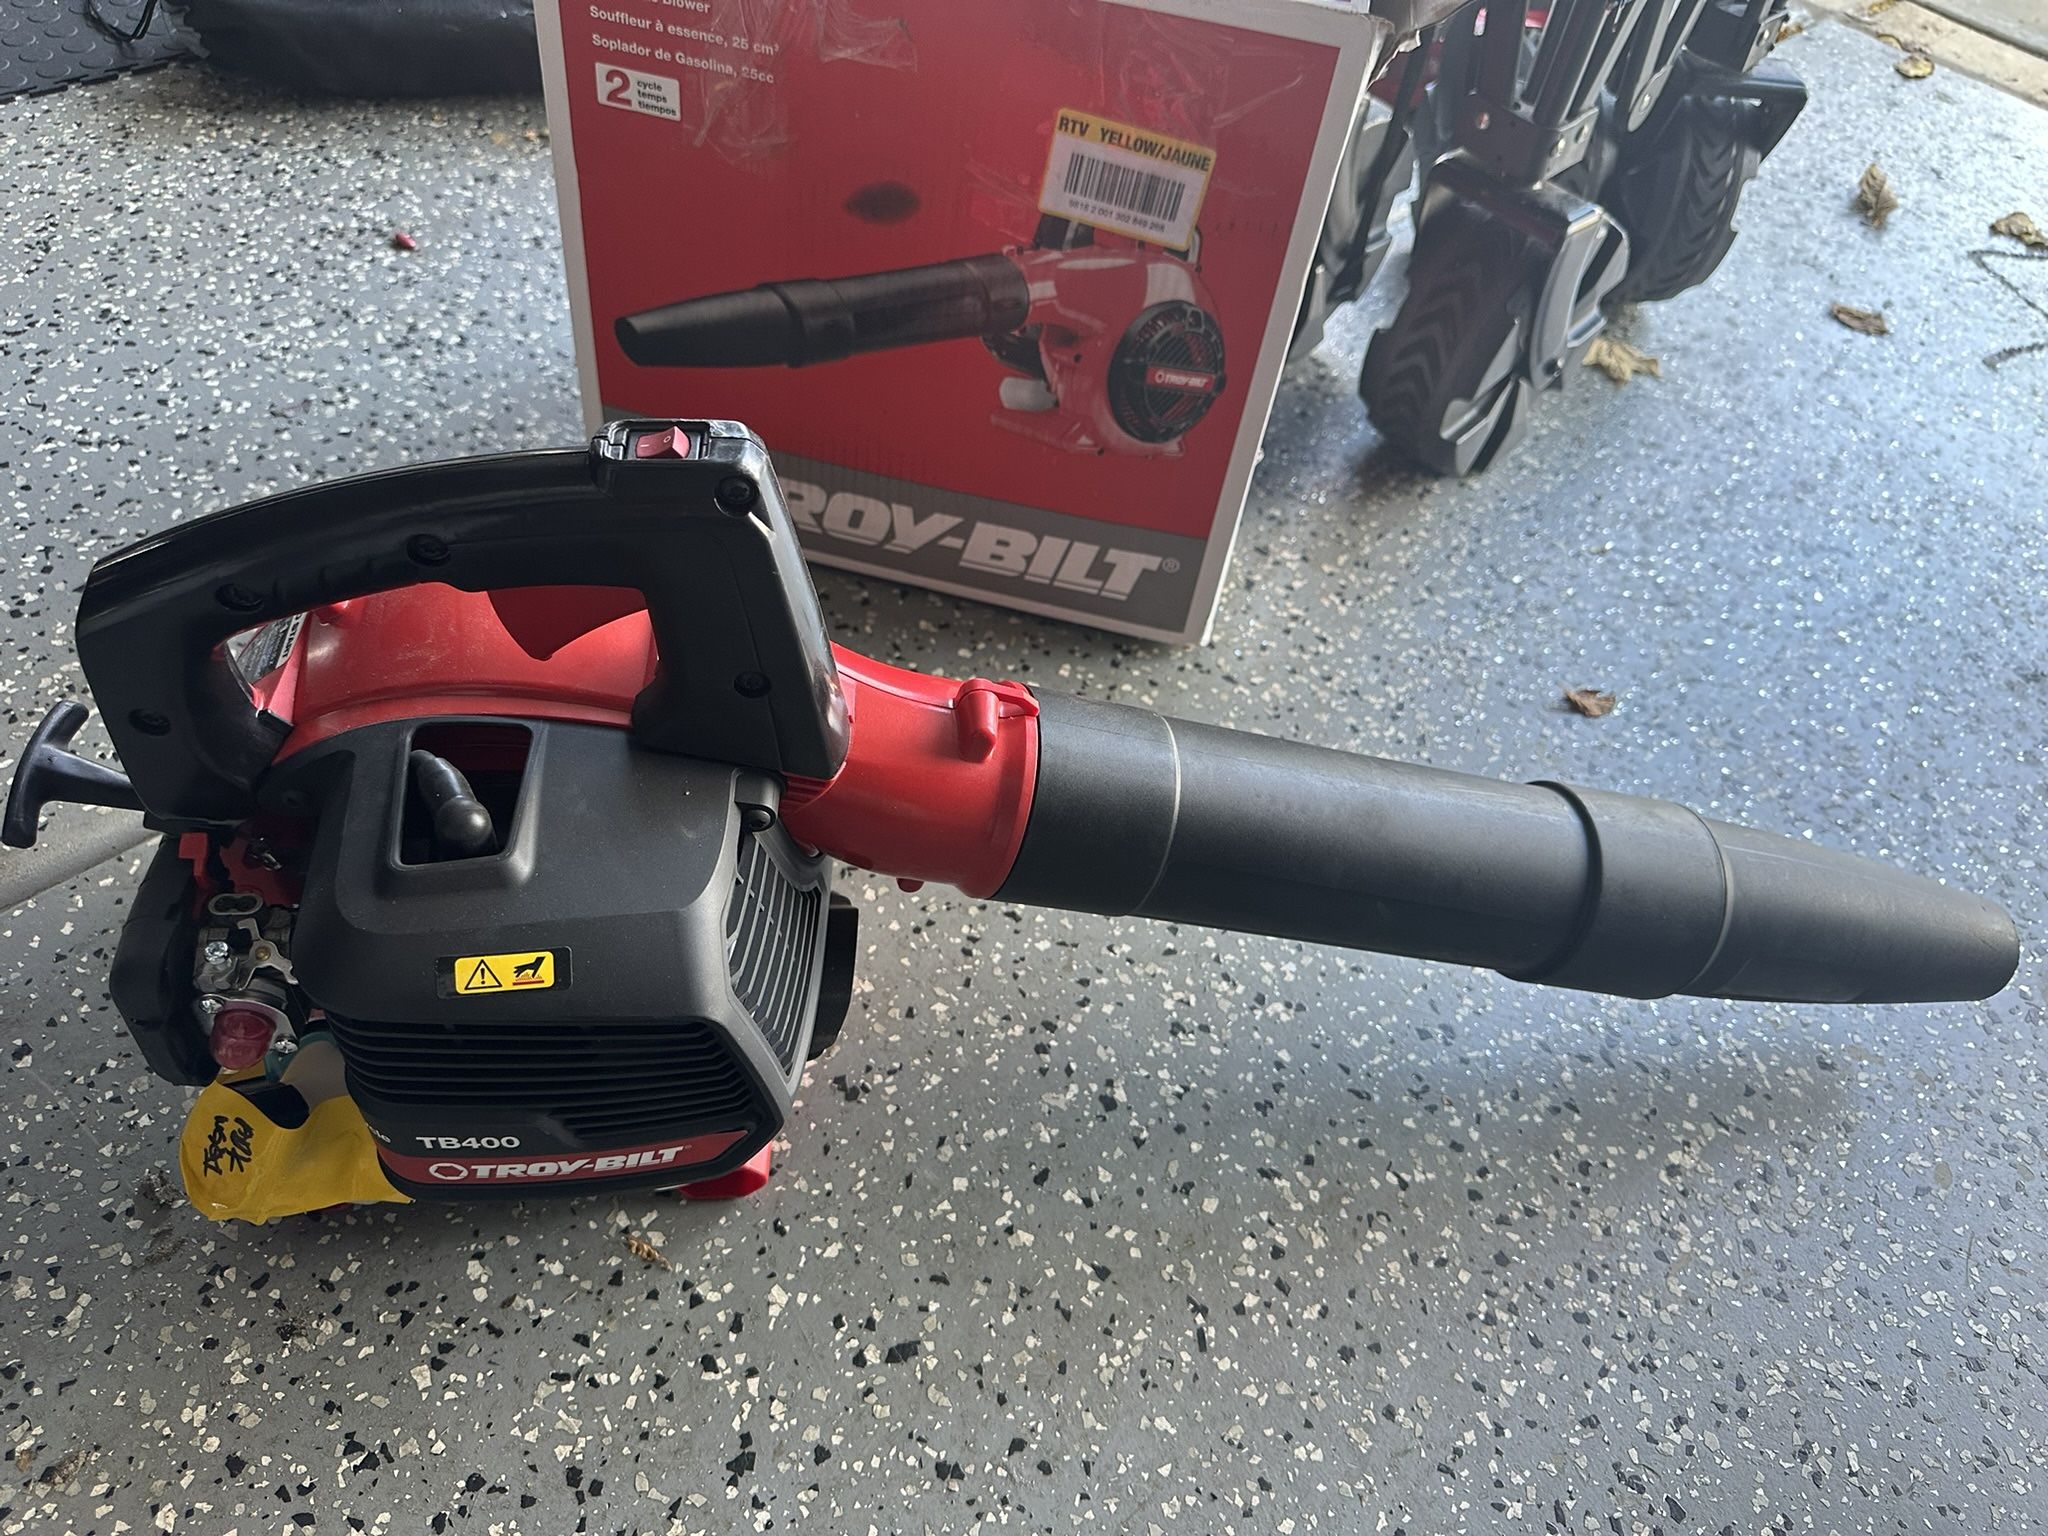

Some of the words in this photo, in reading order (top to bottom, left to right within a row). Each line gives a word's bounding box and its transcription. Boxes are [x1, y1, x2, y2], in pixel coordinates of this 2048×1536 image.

[590, 6, 652, 30] Souffleur
[655, 20, 664, 32] à
[668, 24, 728, 47] essence,
[732, 36, 749, 49] 25
[592, 33, 651, 57] Soplador
[655, 48, 671, 62] de
[676, 52, 737, 78] Gasolina,
[741, 66, 775, 84] 25cc
[605, 70, 633, 107] 2
[637, 80, 662, 92] cycle
[637, 90, 667, 103] temps
[638, 101, 677, 116] tiempos
[1059, 116, 1089, 137] RTV
[1100, 127, 1212, 172] YELLOW/JAUNE
[416, 1136, 521, 1149] TB400
[471, 1146, 684, 1179] TROY-BILT
